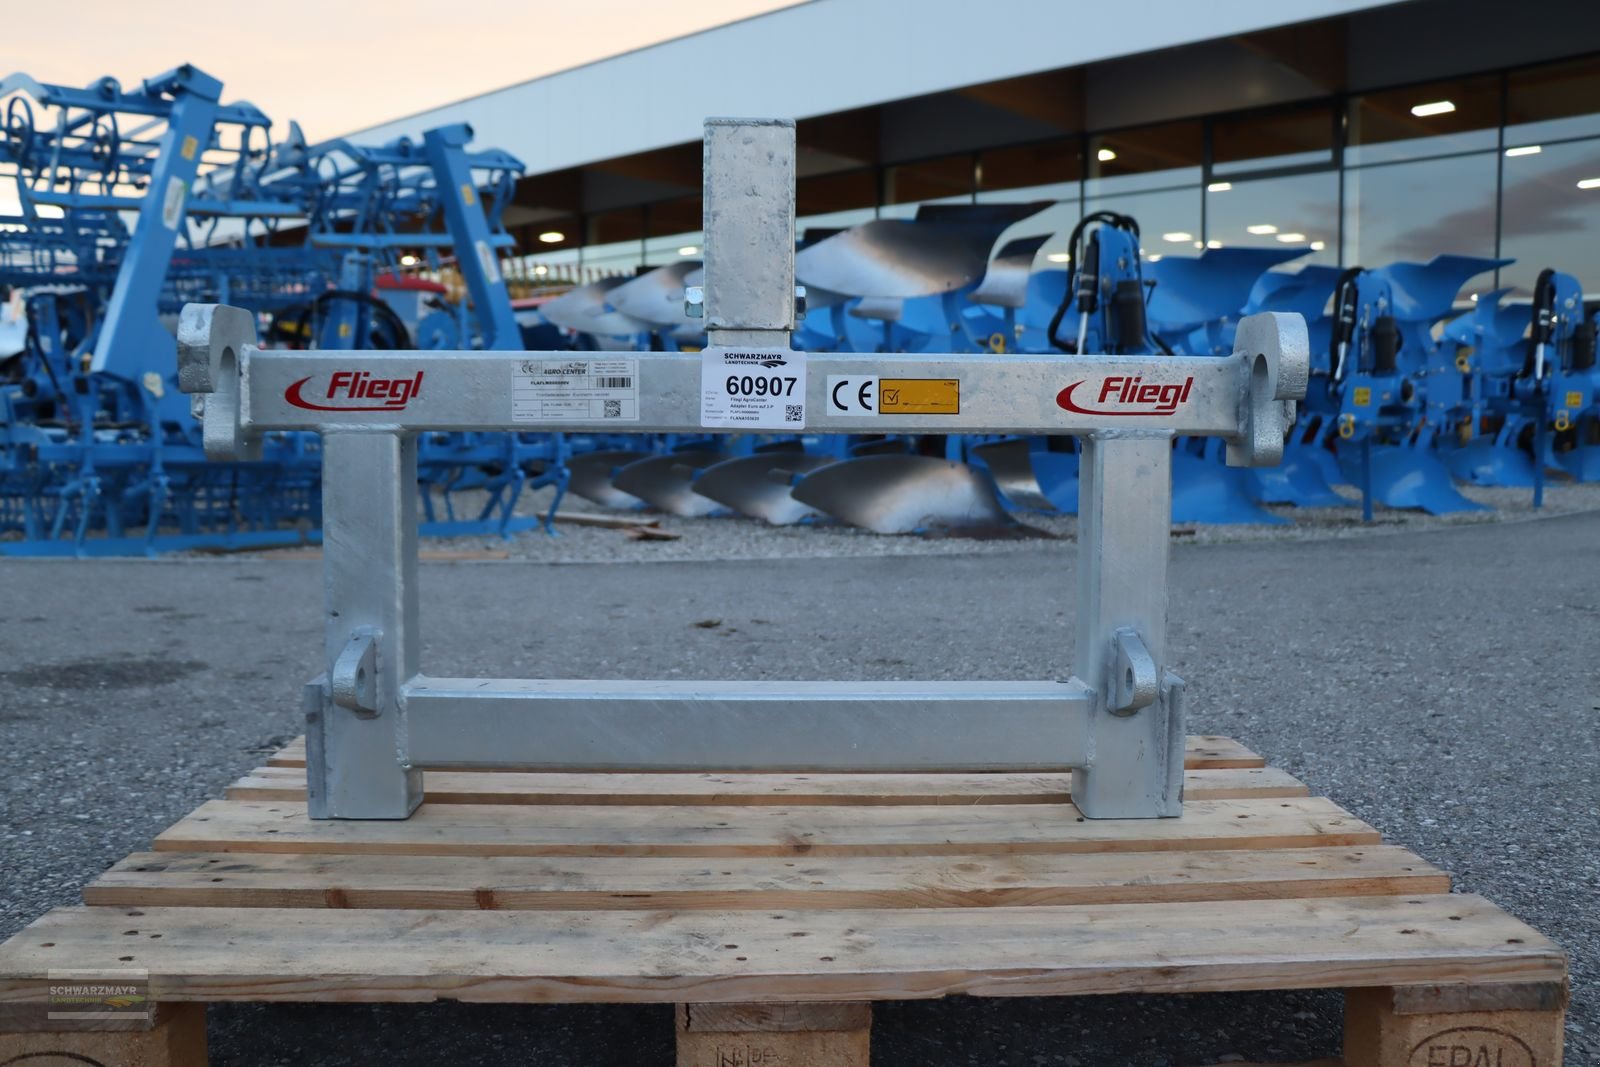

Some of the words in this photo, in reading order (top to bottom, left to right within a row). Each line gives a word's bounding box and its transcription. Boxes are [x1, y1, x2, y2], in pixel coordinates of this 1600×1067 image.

[724, 352, 782, 360] SCHWARZMAYR
[326, 370, 425, 405] Fliegl
[726, 375, 797, 397] 60907
[1097, 376, 1194, 410] Fliegl
